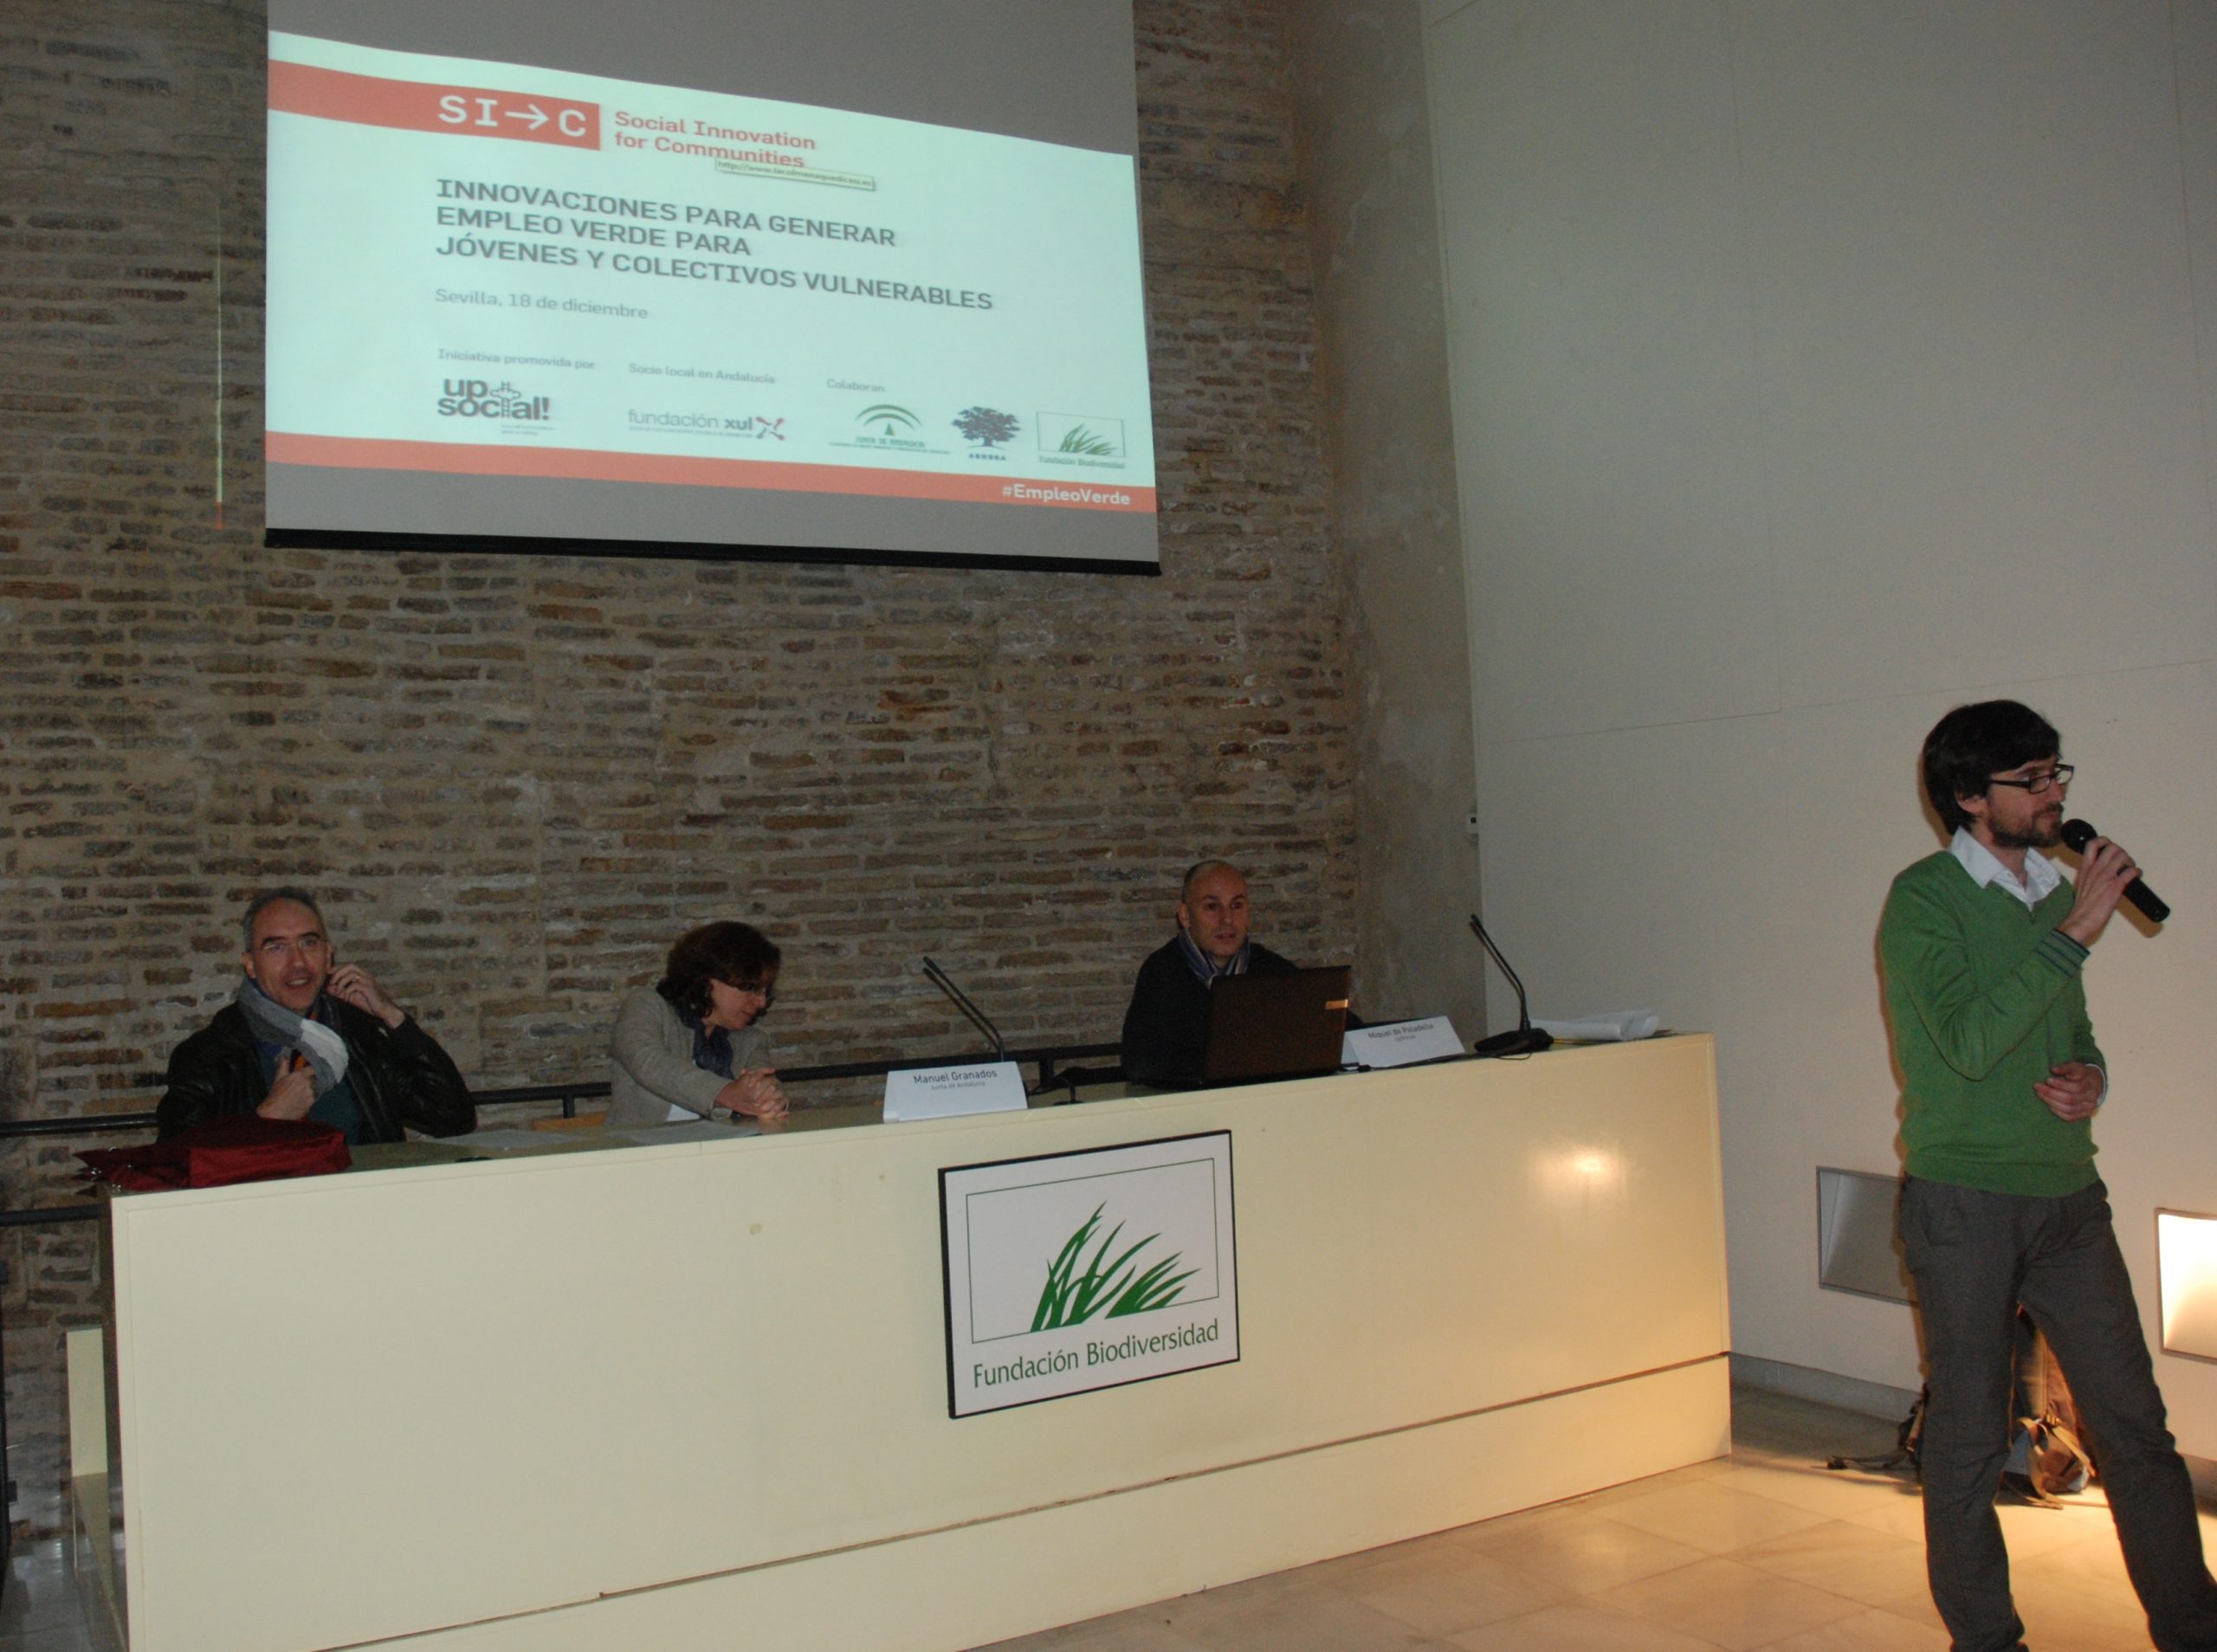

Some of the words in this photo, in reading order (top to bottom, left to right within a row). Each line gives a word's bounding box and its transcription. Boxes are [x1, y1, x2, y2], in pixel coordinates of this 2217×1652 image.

[615, 111, 687, 133] Social
[694, 120, 817, 150] Innovation
[615, 132, 648, 149] for
[654, 137, 805, 168] Communities
[436, 178, 677, 221] INNOVACIONES
[686, 206, 761, 231] PARA
[768, 216, 896, 247] GENERAR
[436, 206, 562, 235] EMPLEO
[570, 218, 667, 247] VERDE
[675, 231, 752, 256] PARA
[436, 233, 578, 267] JÓVENES
[586, 249, 604, 269] Y
[612, 254, 797, 287] COLECTIVOS
[803, 271, 993, 310] VULNERABLES
[435, 287, 503, 308] Sevilla,
[509, 294, 531, 308] 18
[536, 296, 558, 310] de
[562, 298, 649, 319] diciembre
[437, 348, 501, 363] Iniciativa
[504, 353, 572, 368] promovida
[575, 359, 596, 371] por
[628, 363, 663, 375] Socio
[665, 366, 694, 378] local
[698, 370, 713, 379] en
[716, 370, 776, 384] Andalucía
[826, 378, 885, 392] Colaboran
[443, 378, 489, 401] up
[628, 408, 719, 429] fundación
[725, 416, 753, 431] xul
[1002, 483, 1131, 506] #EmpleoVerde
[914, 1073, 949, 1084] Manuel
[951, 1069, 998, 1081] Granados
[973, 1349, 1079, 1389] Fundación
[1086, 1318, 1219, 1367] Biodiversidad
